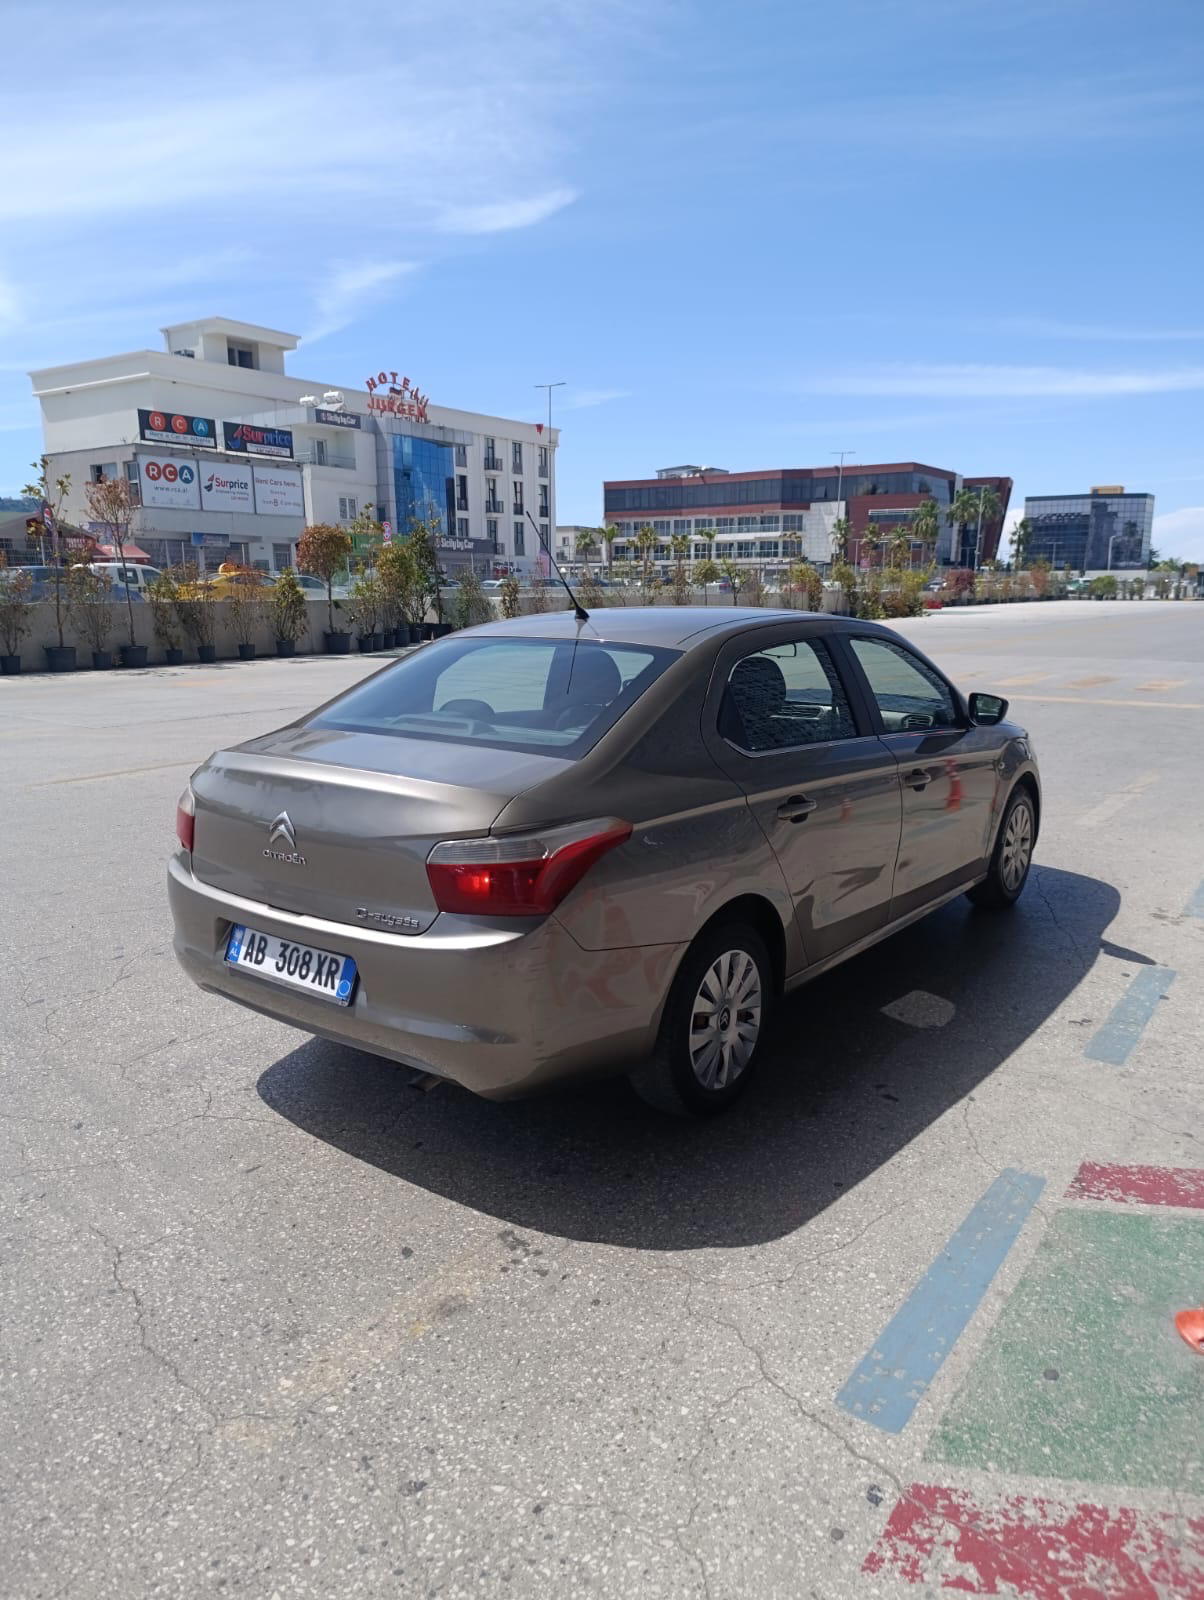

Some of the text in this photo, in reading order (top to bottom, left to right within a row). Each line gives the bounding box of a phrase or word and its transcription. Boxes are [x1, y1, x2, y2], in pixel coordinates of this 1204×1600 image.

[243, 425, 291, 446] Surprice
[148, 464, 193, 481] RCA
[215, 477, 248, 490] Surprice
[269, 478, 282, 486] Cars
[464, 538, 474, 549] Car
[229, 947, 238, 957] AL
[243, 932, 268, 965] AB
